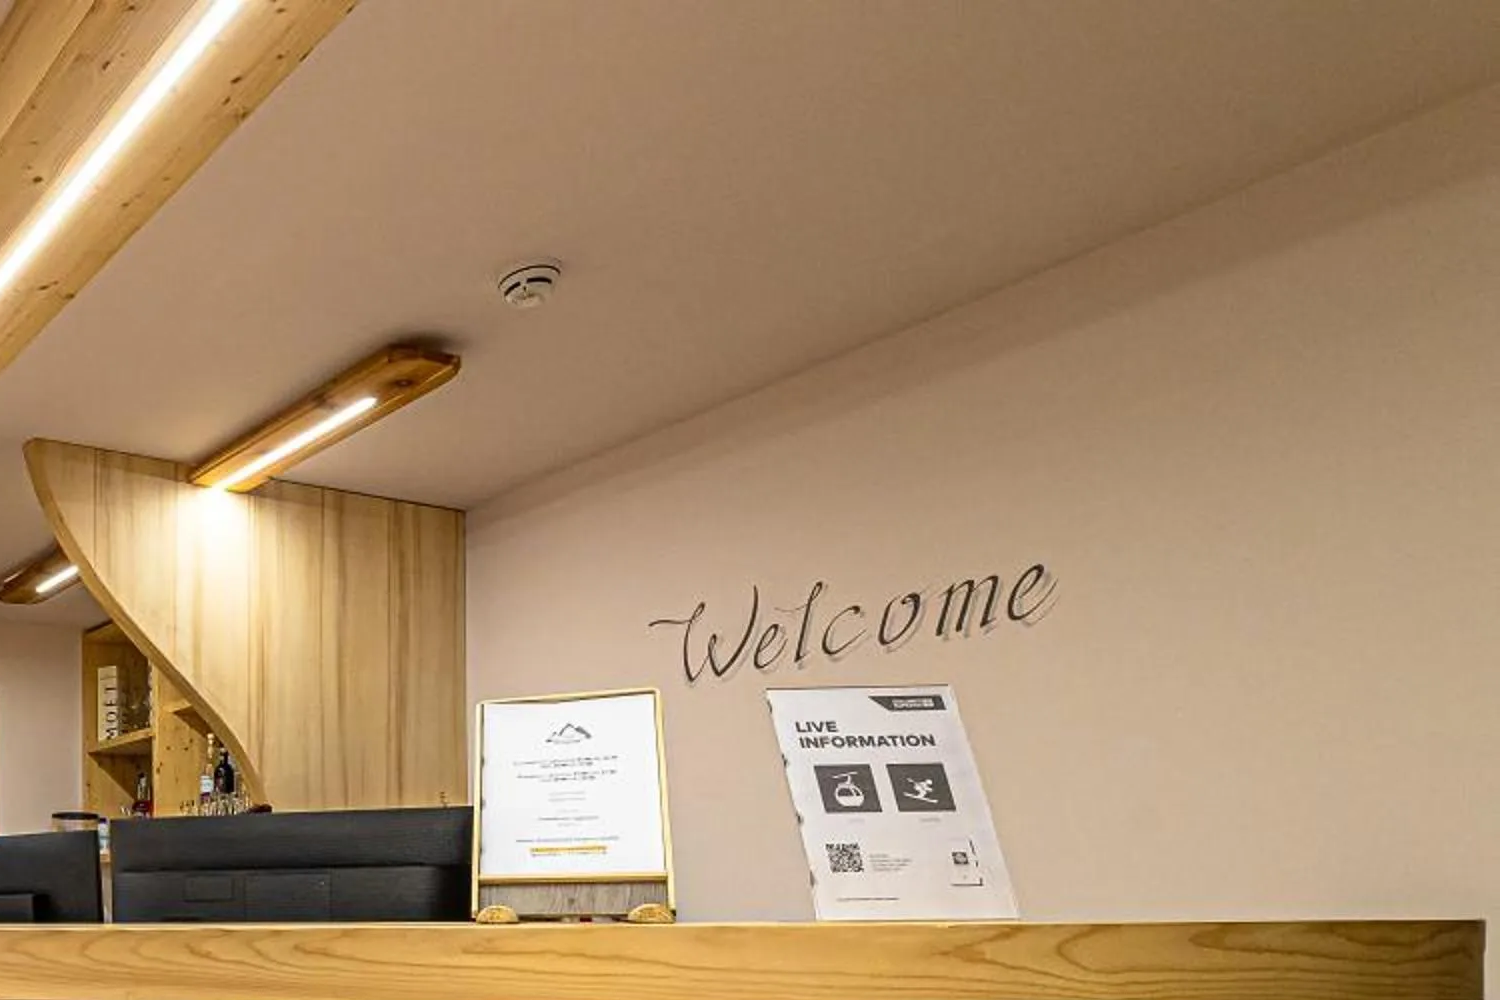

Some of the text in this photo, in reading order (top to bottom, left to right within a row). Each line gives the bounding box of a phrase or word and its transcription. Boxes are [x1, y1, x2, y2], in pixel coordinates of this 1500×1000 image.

[648, 563, 1058, 683] Welcome
[795, 721, 839, 733] LIVE
[799, 733, 937, 749] INFORMATION
